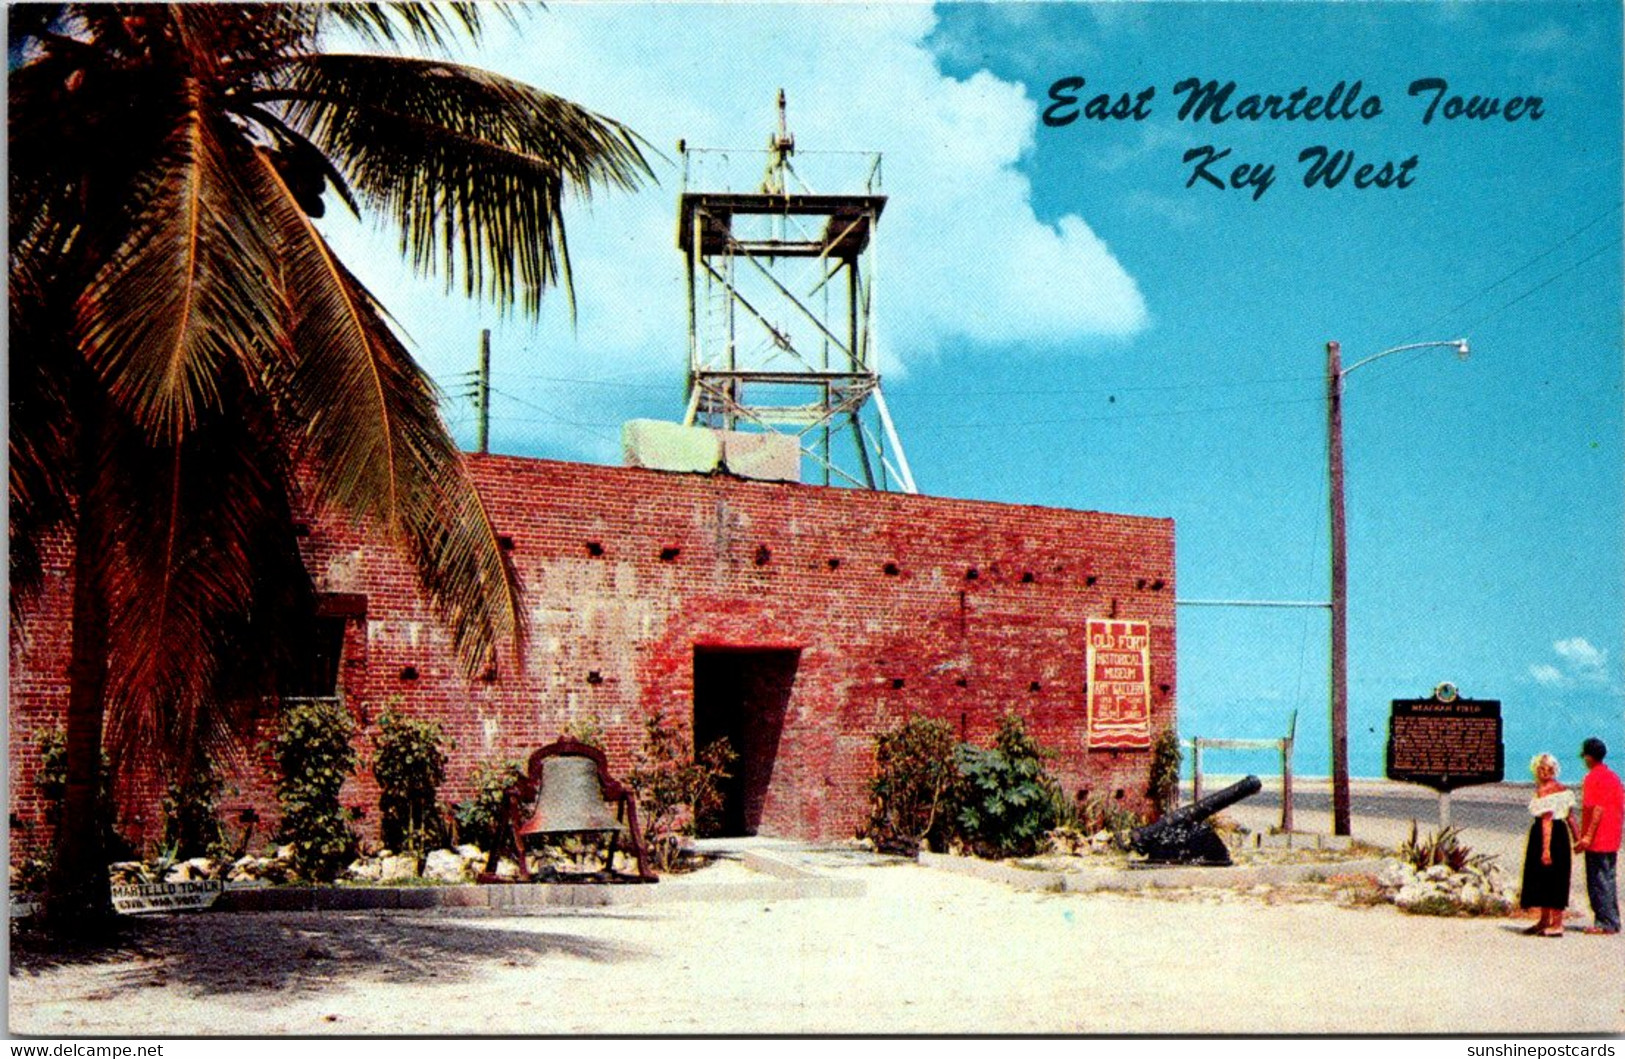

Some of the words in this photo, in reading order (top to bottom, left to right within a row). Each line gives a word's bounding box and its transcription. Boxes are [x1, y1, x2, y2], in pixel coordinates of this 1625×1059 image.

[1094, 634, 1115, 649] OLD
[1119, 635, 1147, 650] FORT
[1096, 653, 1142, 666] HISTORICAL
[1103, 667, 1136, 680] MUSEUM
[1094, 682, 1110, 694] ART
[1113, 683, 1145, 695] GALLERY
[1456, 704, 1481, 713] FIELD
[112, 884, 176, 898] MARTELLO
[179, 880, 218, 893] TOWER
